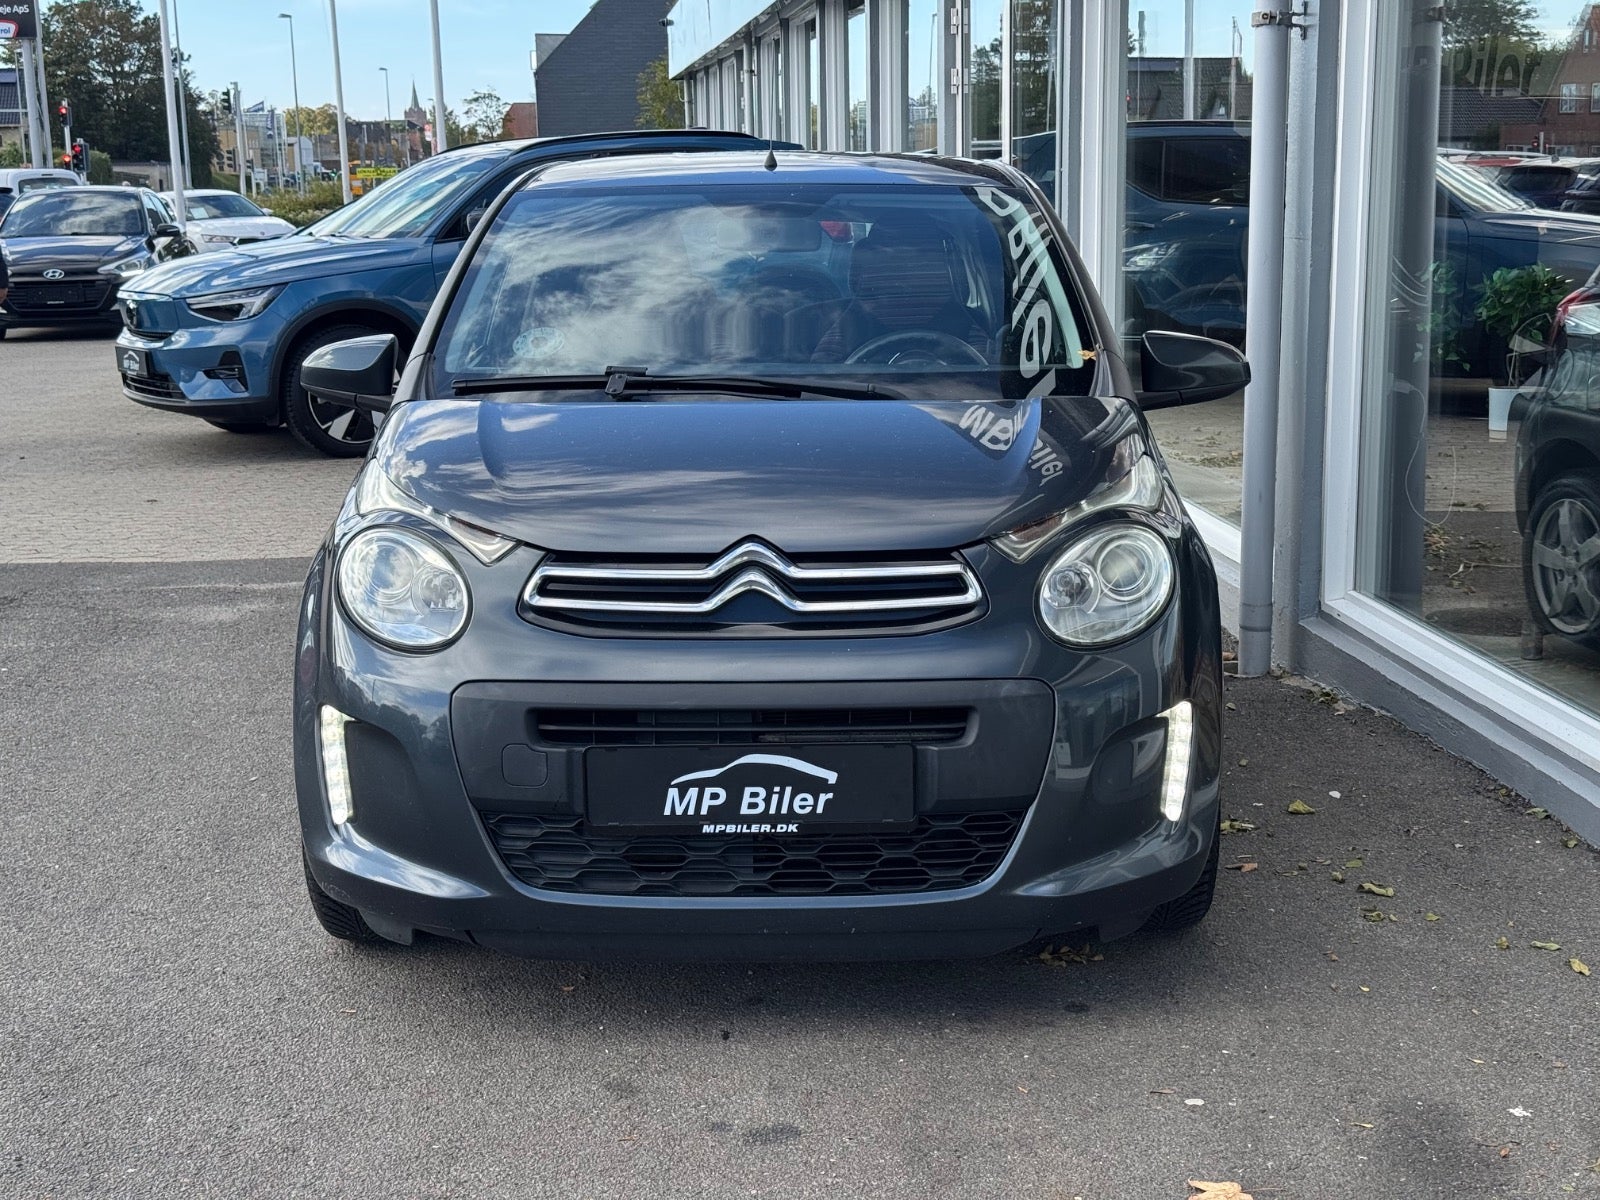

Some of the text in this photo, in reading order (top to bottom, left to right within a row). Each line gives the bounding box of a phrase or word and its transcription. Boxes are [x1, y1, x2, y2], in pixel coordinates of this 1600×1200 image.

[12, 4, 30, 15] ApS
[663, 785, 834, 816] MP Biler
[701, 823, 799, 833] MPBILER.DK
